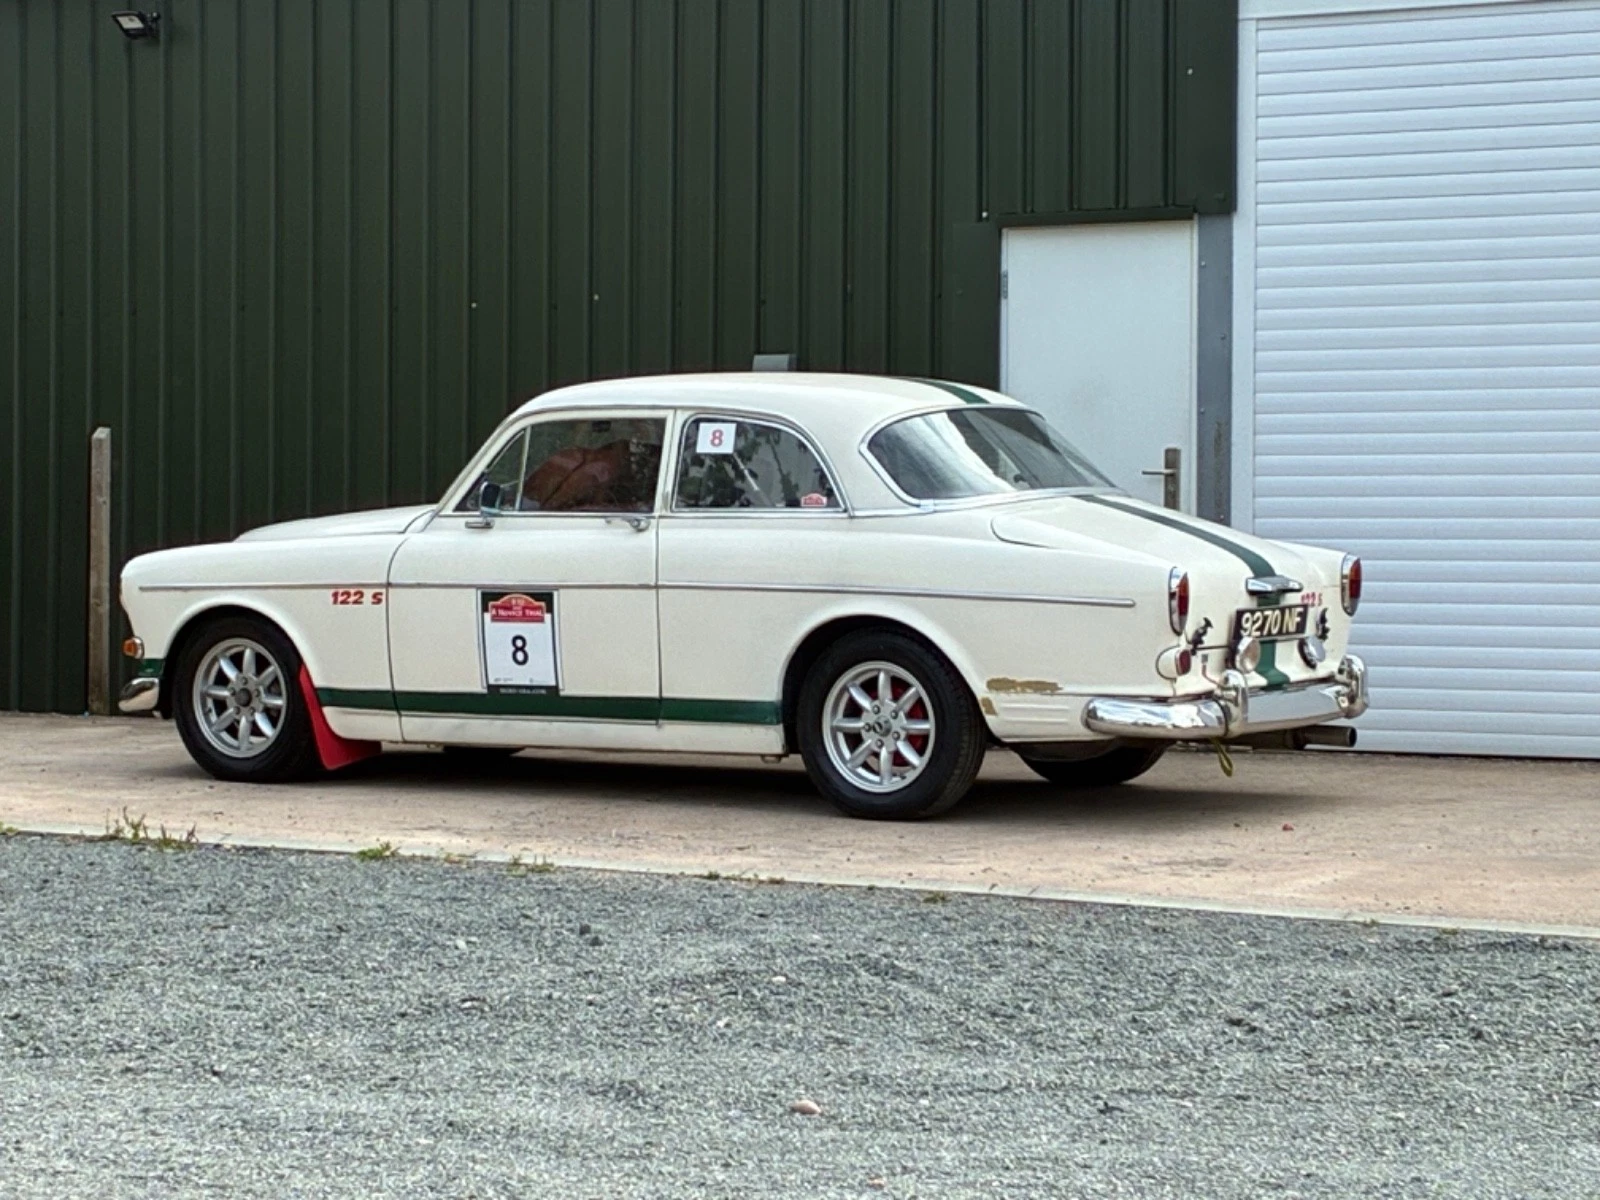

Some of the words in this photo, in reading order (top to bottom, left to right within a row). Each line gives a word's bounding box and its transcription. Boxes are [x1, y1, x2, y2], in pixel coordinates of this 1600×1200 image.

[711, 429, 724, 447] 8
[331, 590, 364, 605] 122
[1241, 609, 1281, 637] 9270
[1282, 607, 1304, 633] NF
[511, 634, 529, 666] 8
